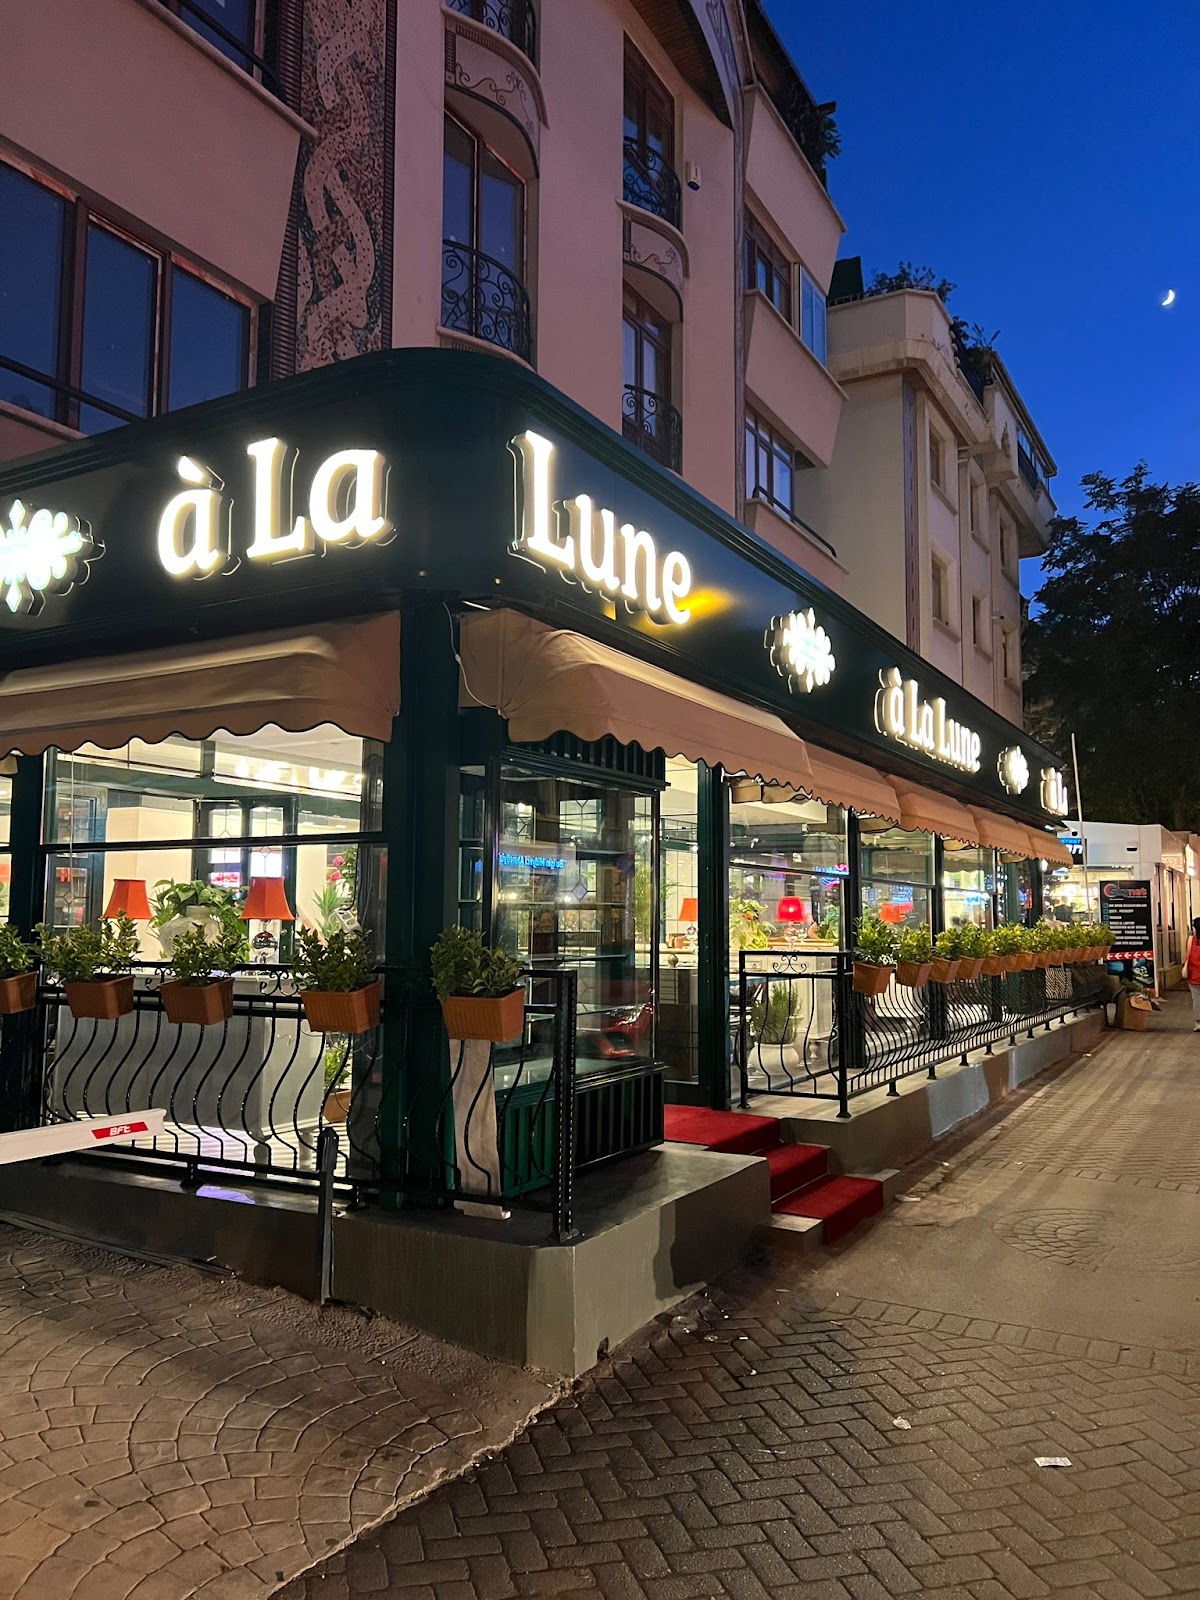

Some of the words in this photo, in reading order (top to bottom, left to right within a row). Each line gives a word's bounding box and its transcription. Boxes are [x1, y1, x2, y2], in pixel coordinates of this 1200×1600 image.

[157, 454, 229, 577] à
[245, 436, 392, 562] La
[510, 428, 694, 625] Lune
[932, 697, 982, 773] Lune
